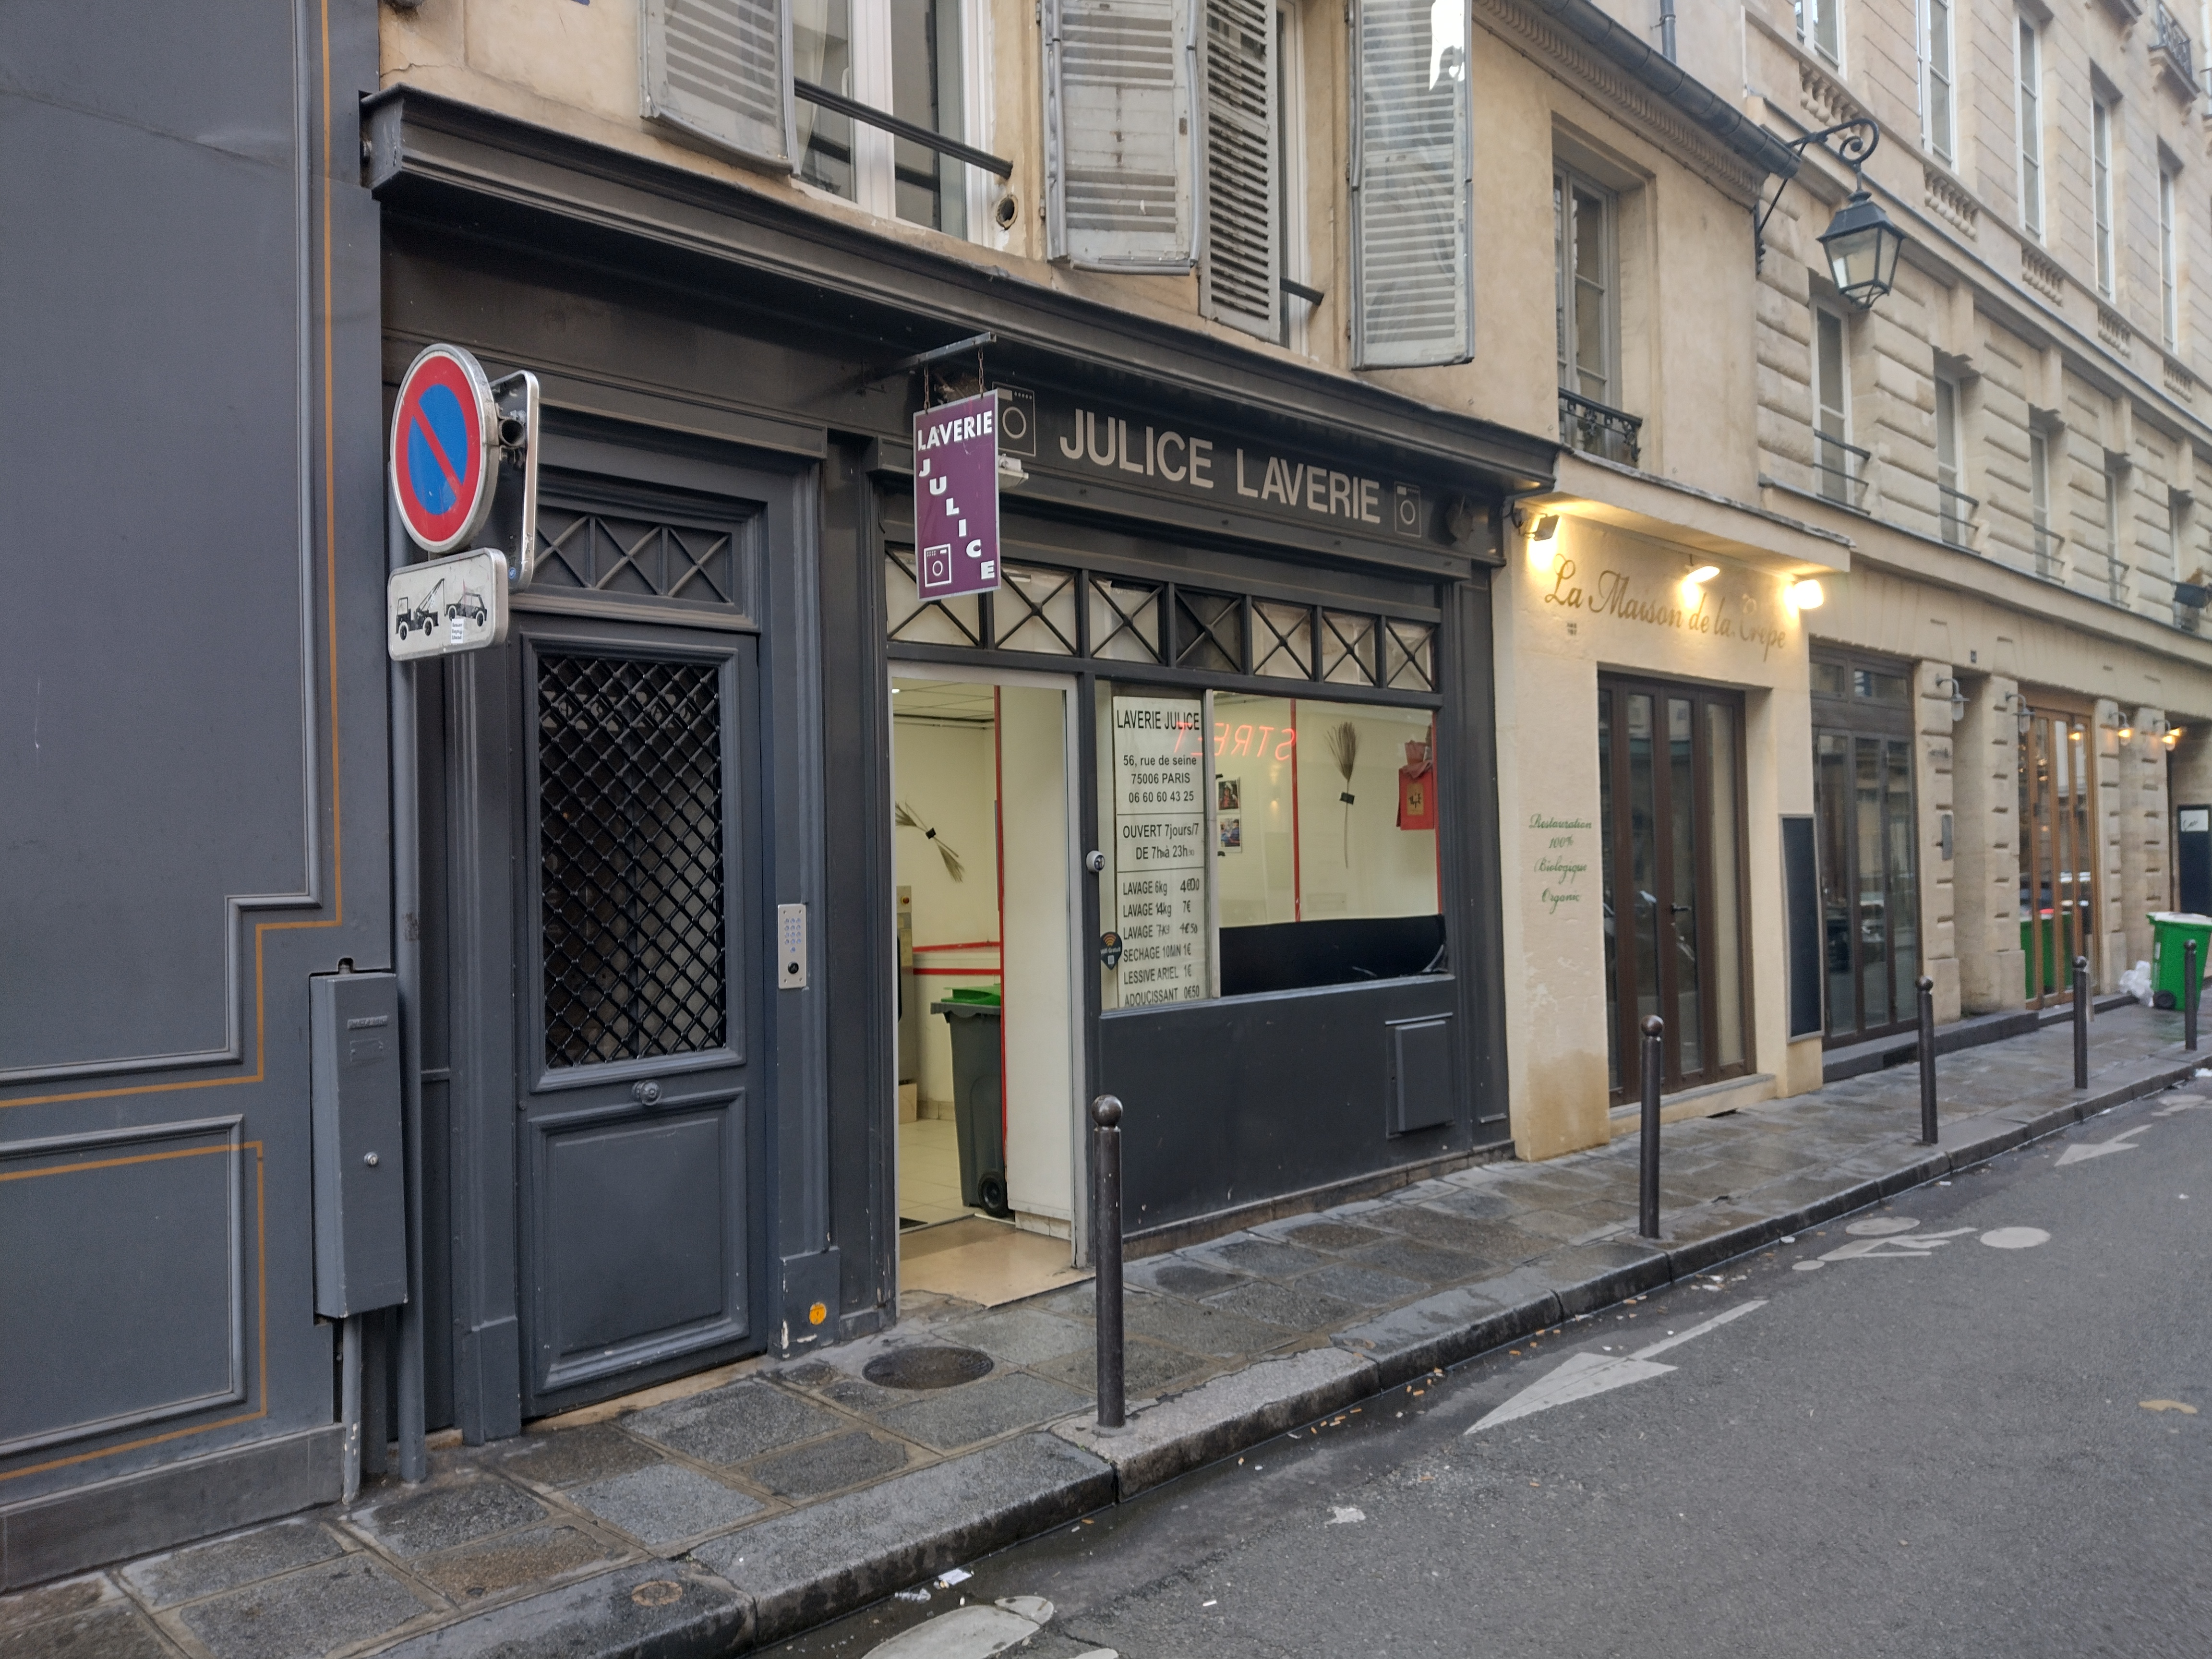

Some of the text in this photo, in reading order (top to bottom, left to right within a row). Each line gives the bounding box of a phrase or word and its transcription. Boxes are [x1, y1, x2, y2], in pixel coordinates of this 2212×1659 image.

[918, 410, 993, 451] LAVERIE
[1060, 409, 1381, 524] JULICE LAVERIE
[1545, 553, 1583, 608] La
[1588, 570, 1683, 628] Maison
[1689, 592, 1709, 634] de
[1714, 597, 1732, 636] la
[1117, 709, 1200, 730] LAVERIE JULICE
[1123, 755, 1197, 768] 56, rue de seine
[1131, 772, 1190, 784] 75006 PARIS
[1129, 791, 1194, 803] 06 60 60 43 25
[1528, 813, 1592, 829] Restauration
[1123, 822, 1199, 840] OUVERT 7jours/7
[1549, 835, 1574, 848] 100%
[1136, 847, 1148, 860] DE
[1534, 855, 1587, 884] Biologique
[1123, 881, 1153, 895] LAVAGE
[1155, 880, 1167, 896] 6kg
[1123, 903, 1153, 918] LAVAGE
[1183, 900, 1191, 913] 7€
[1542, 888, 1581, 914] Organic
[1123, 925, 1153, 940] LAVAGE
[1123, 943, 1191, 962] SECHAGE 10MN 1€
[1124, 964, 1191, 985] LESSIVE ARIEL 1€
[1124, 985, 1199, 1007] ADOUCISSANT 0€50
